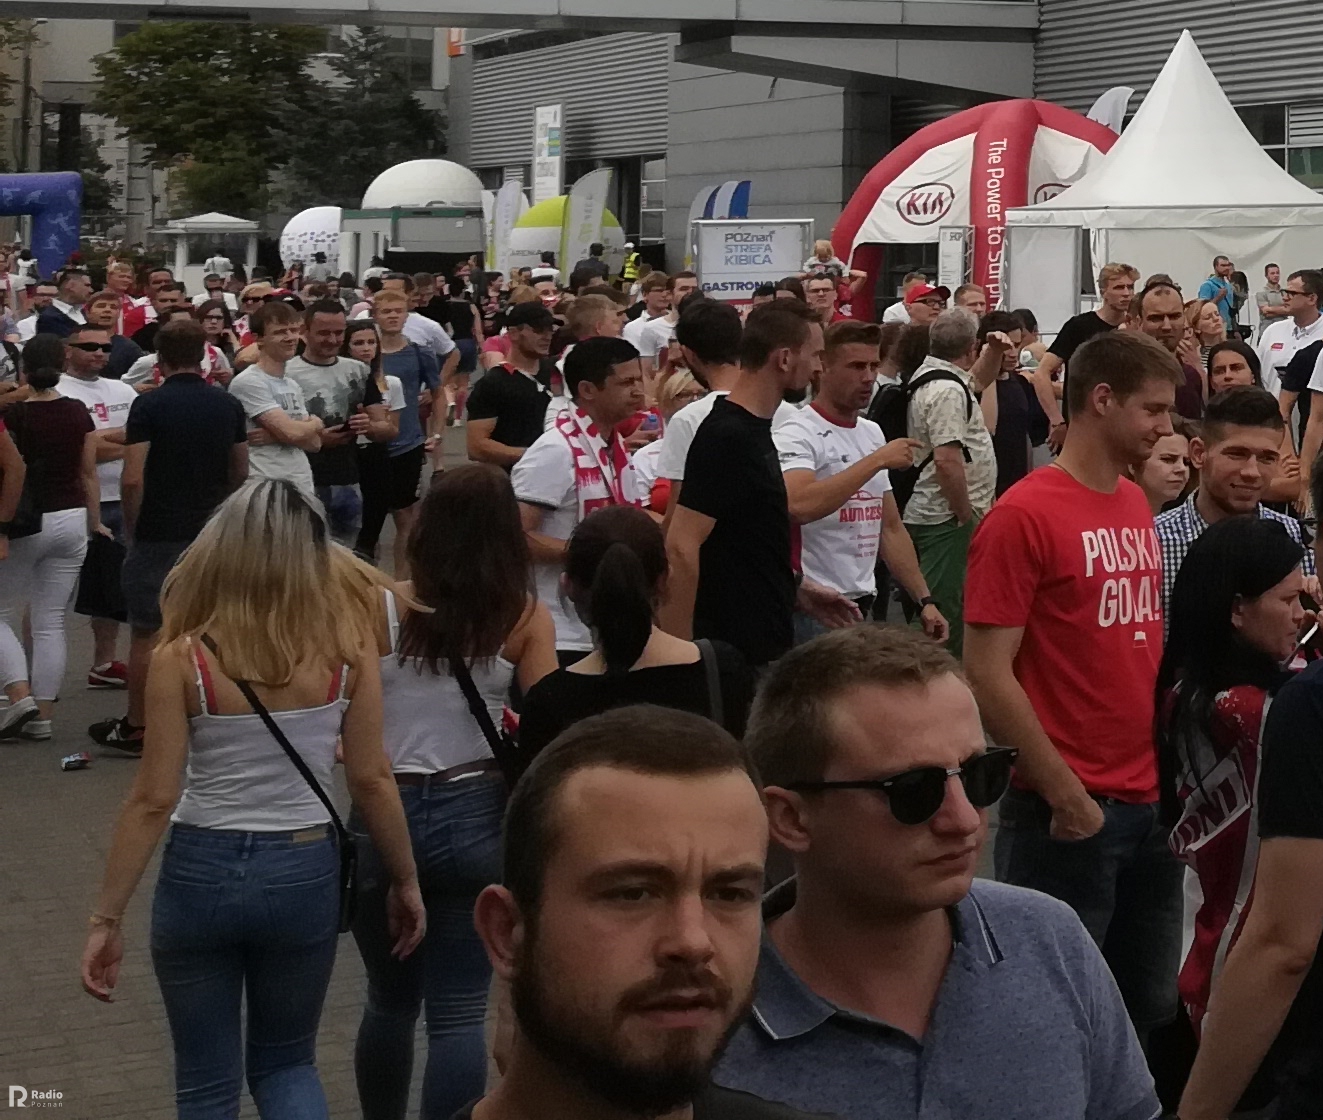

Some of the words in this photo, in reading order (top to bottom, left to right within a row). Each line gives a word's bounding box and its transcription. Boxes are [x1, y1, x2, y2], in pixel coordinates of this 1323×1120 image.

[988, 137, 1007, 164] The
[906, 192, 944, 216] KIA
[986, 167, 1005, 221] Power
[987, 226, 1005, 245] to
[724, 244, 772, 254] STREFA
[724, 254, 773, 265] KIBICA
[1081, 527, 1162, 577] POLSKA
